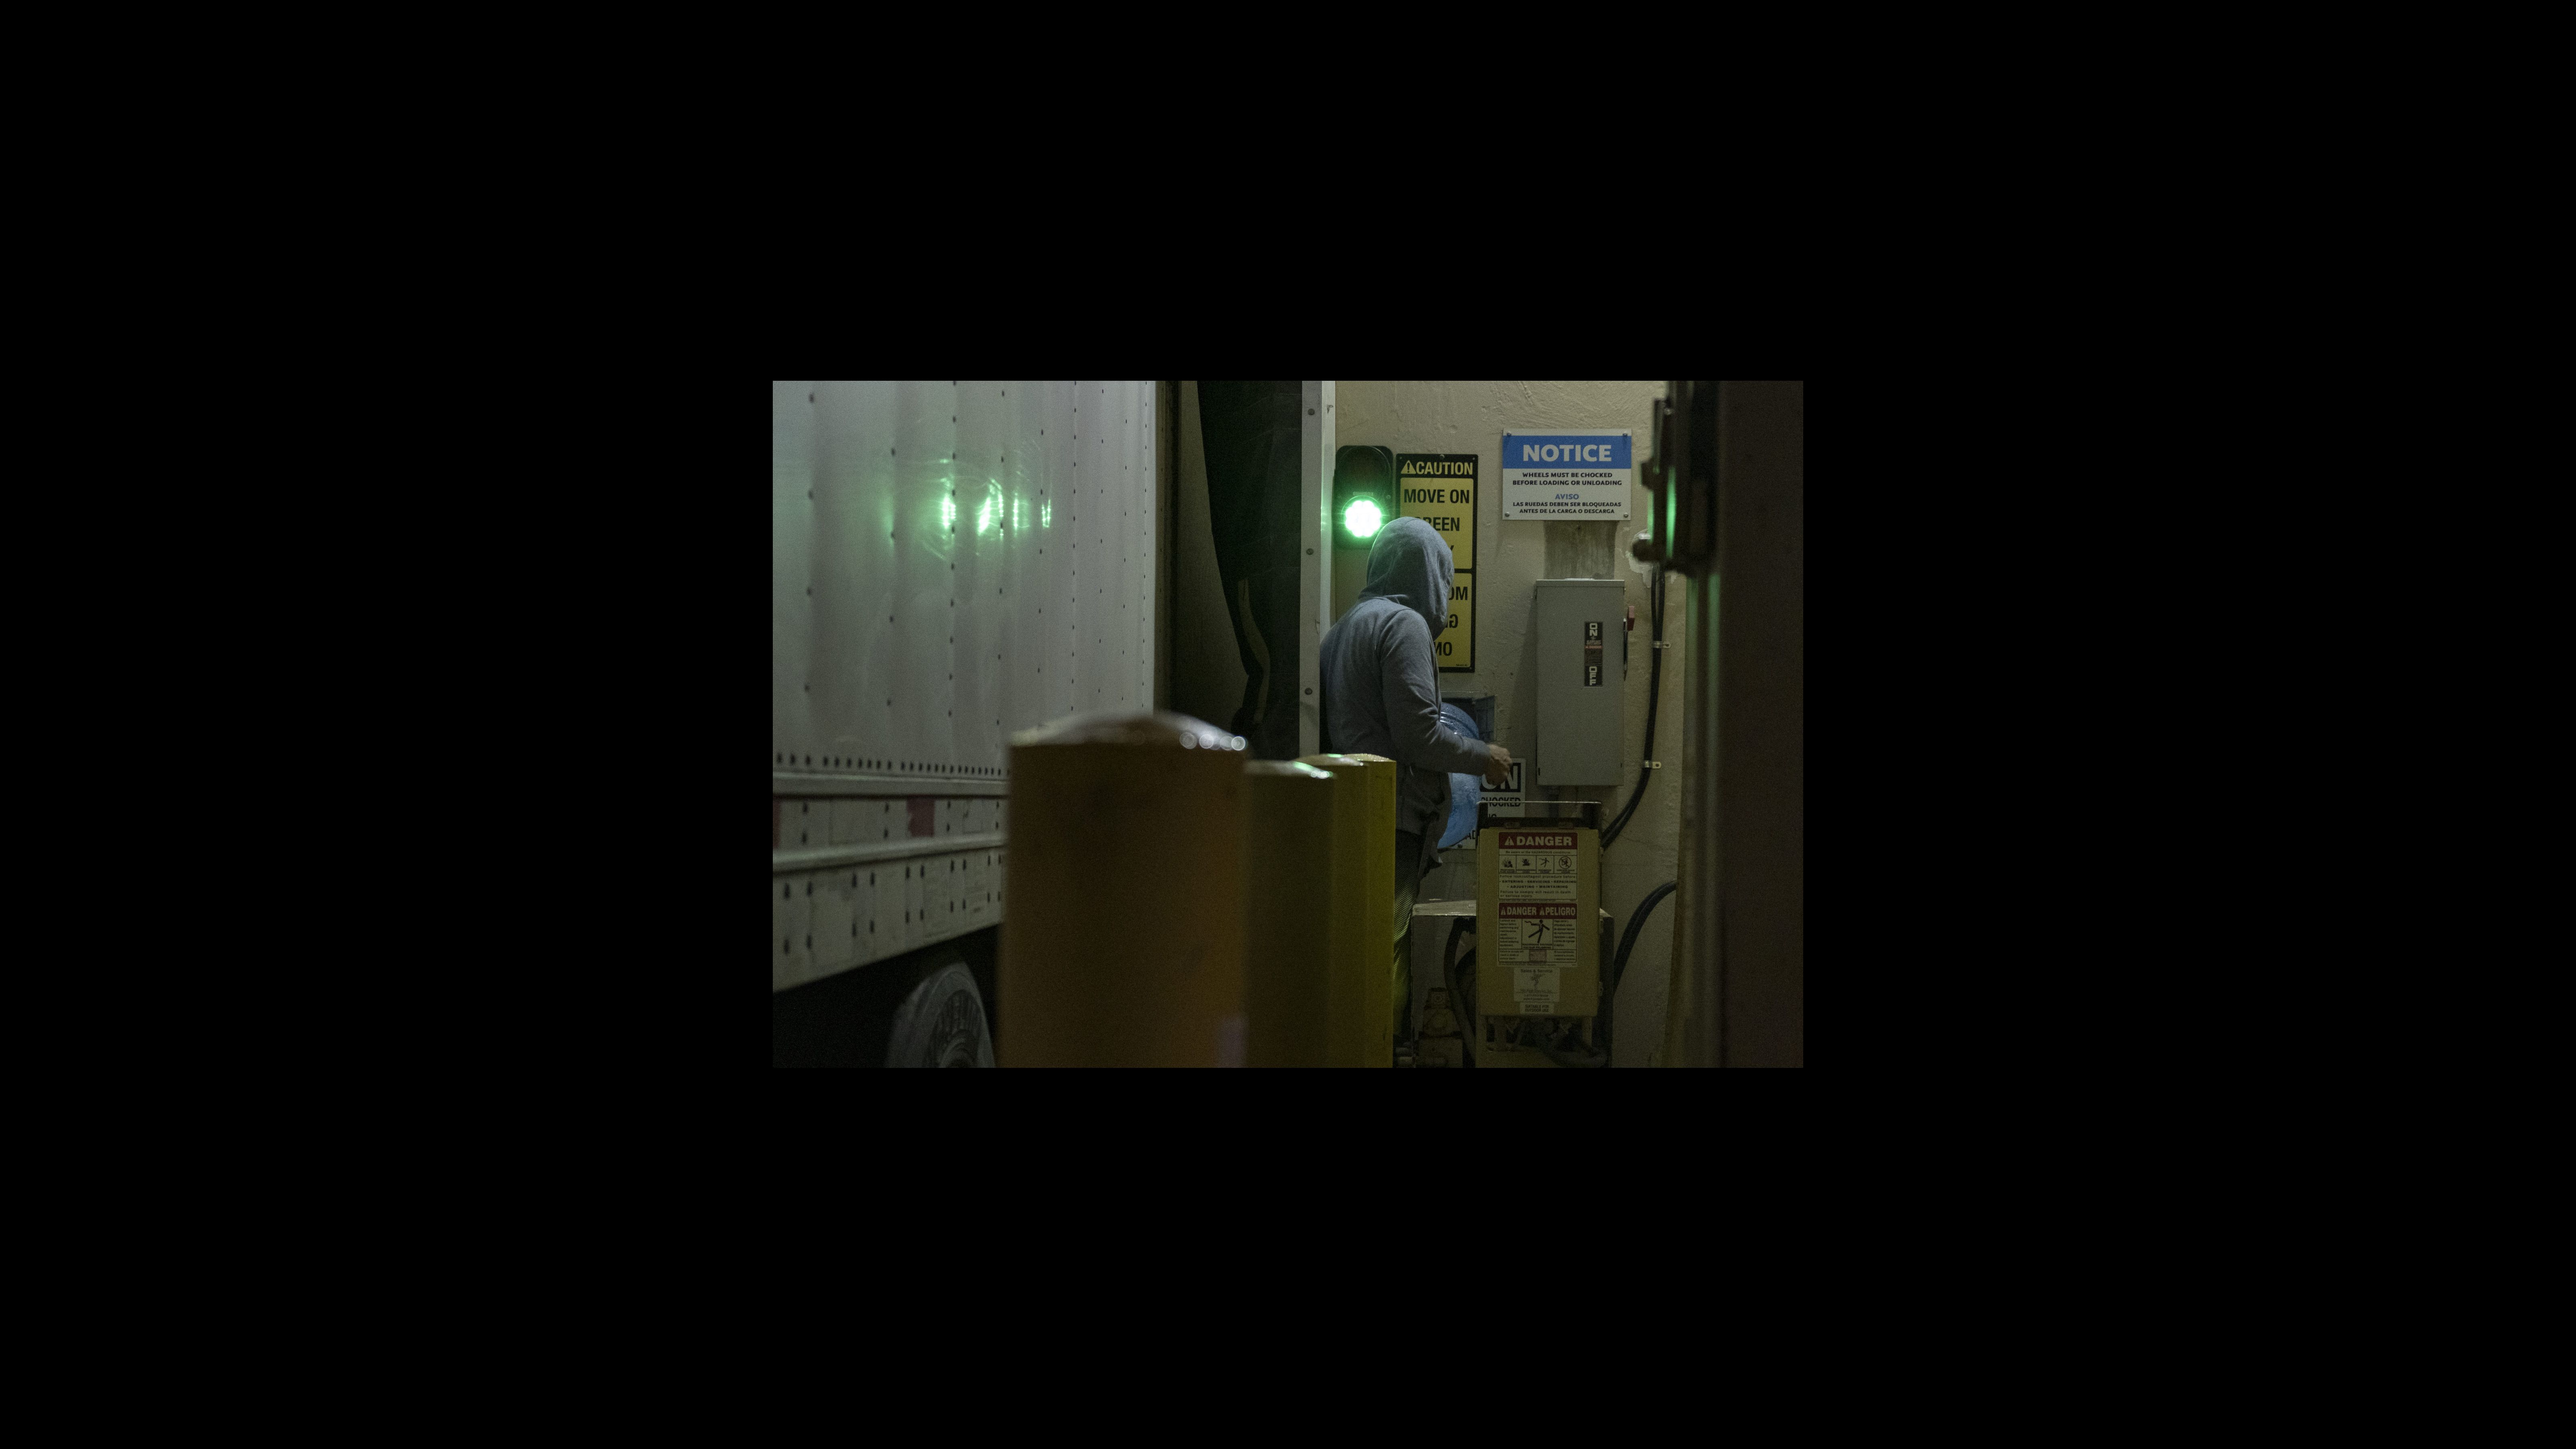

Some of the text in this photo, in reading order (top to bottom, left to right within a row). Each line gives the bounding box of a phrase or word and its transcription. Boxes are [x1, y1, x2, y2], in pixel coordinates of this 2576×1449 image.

[1523, 444, 1612, 462] NOTICE
[1416, 461, 1473, 475] CAUTION
[1404, 489, 1470, 504] MOVE ON
[1415, 517, 1460, 532] EEN
[1589, 623, 1598, 636] ON
[1589, 666, 1598, 686] OFF
[1516, 836, 1572, 846] DANGER
[1507, 907, 1576, 916] DANGER PELIGRO
